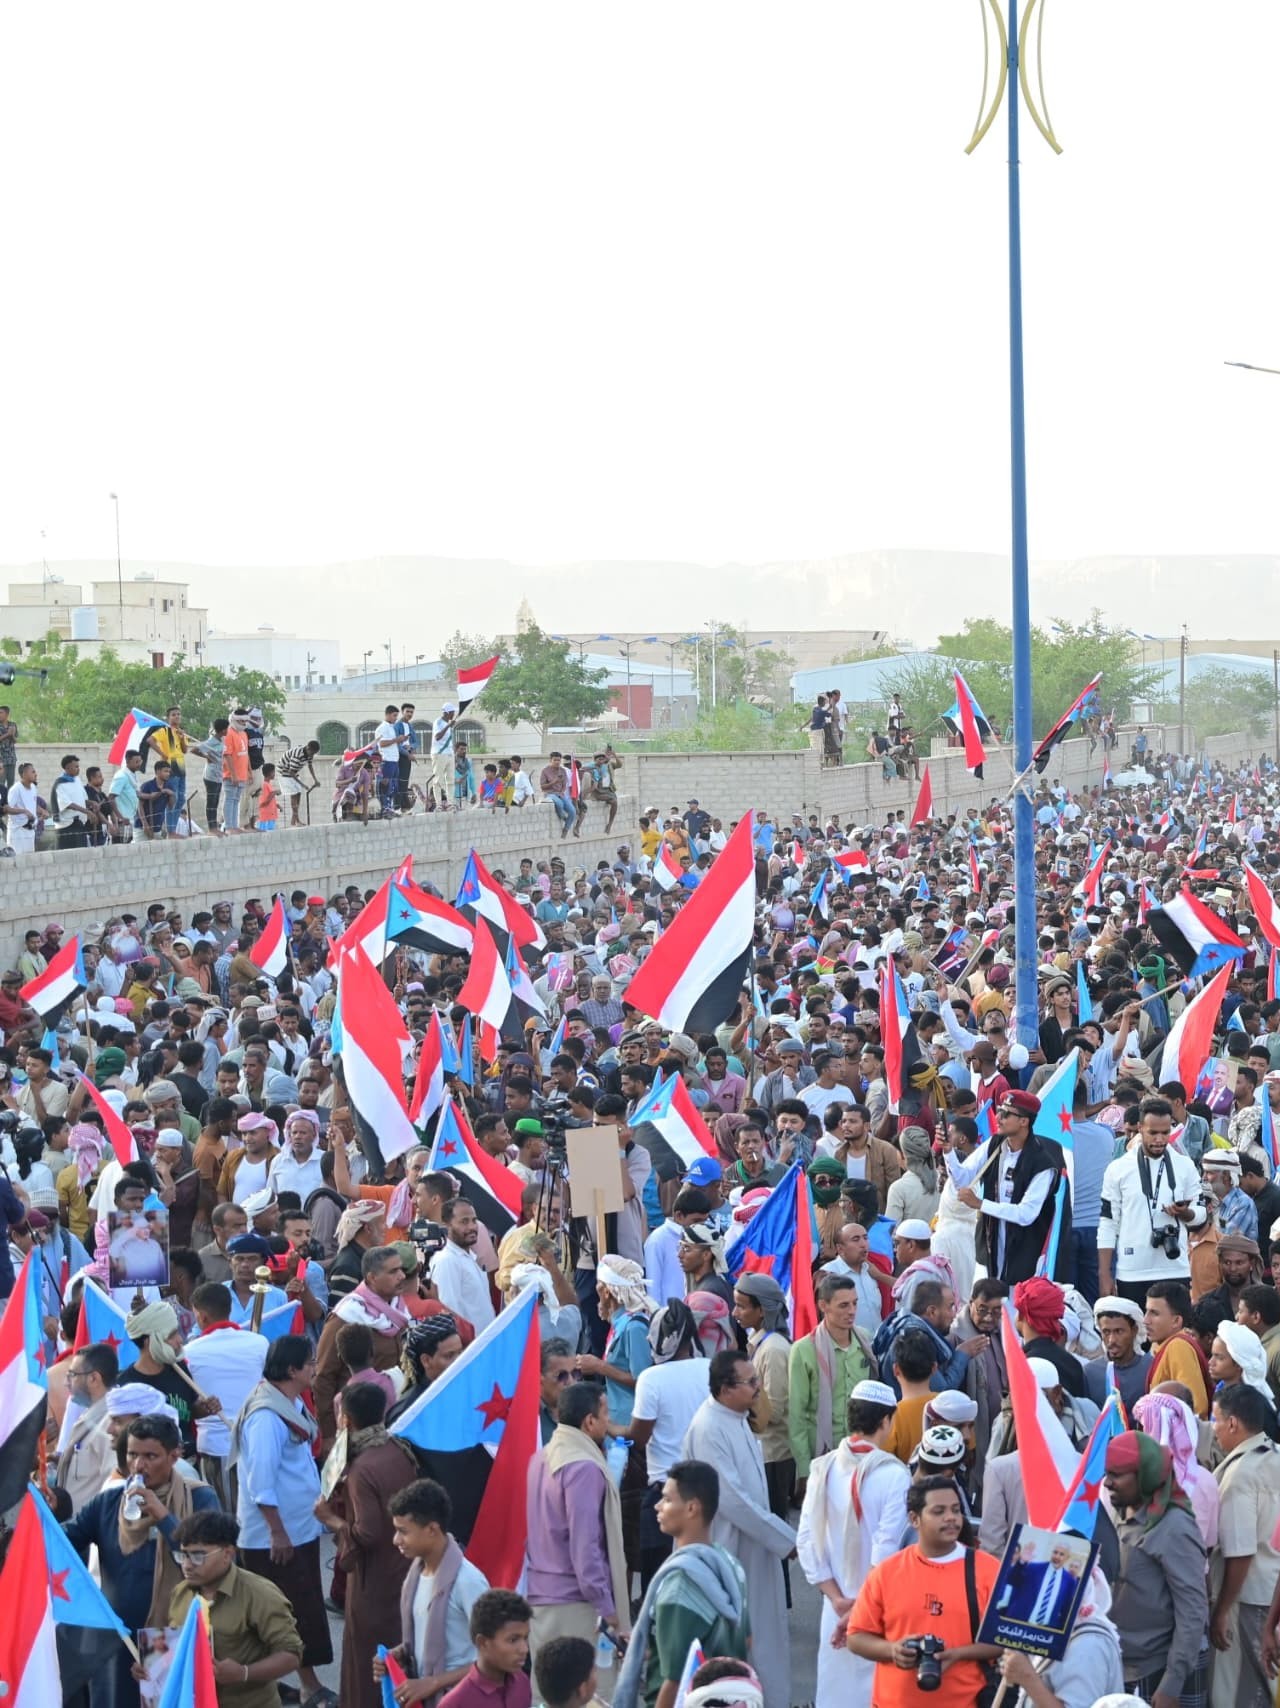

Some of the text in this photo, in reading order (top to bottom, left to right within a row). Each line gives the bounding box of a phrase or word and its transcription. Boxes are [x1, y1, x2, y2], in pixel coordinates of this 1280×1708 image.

[997, 1624, 1023, 1637] الثبات
[1022, 1630, 1037, 1642] رمز
[994, 1635, 1049, 1656] وصوت العدالة
